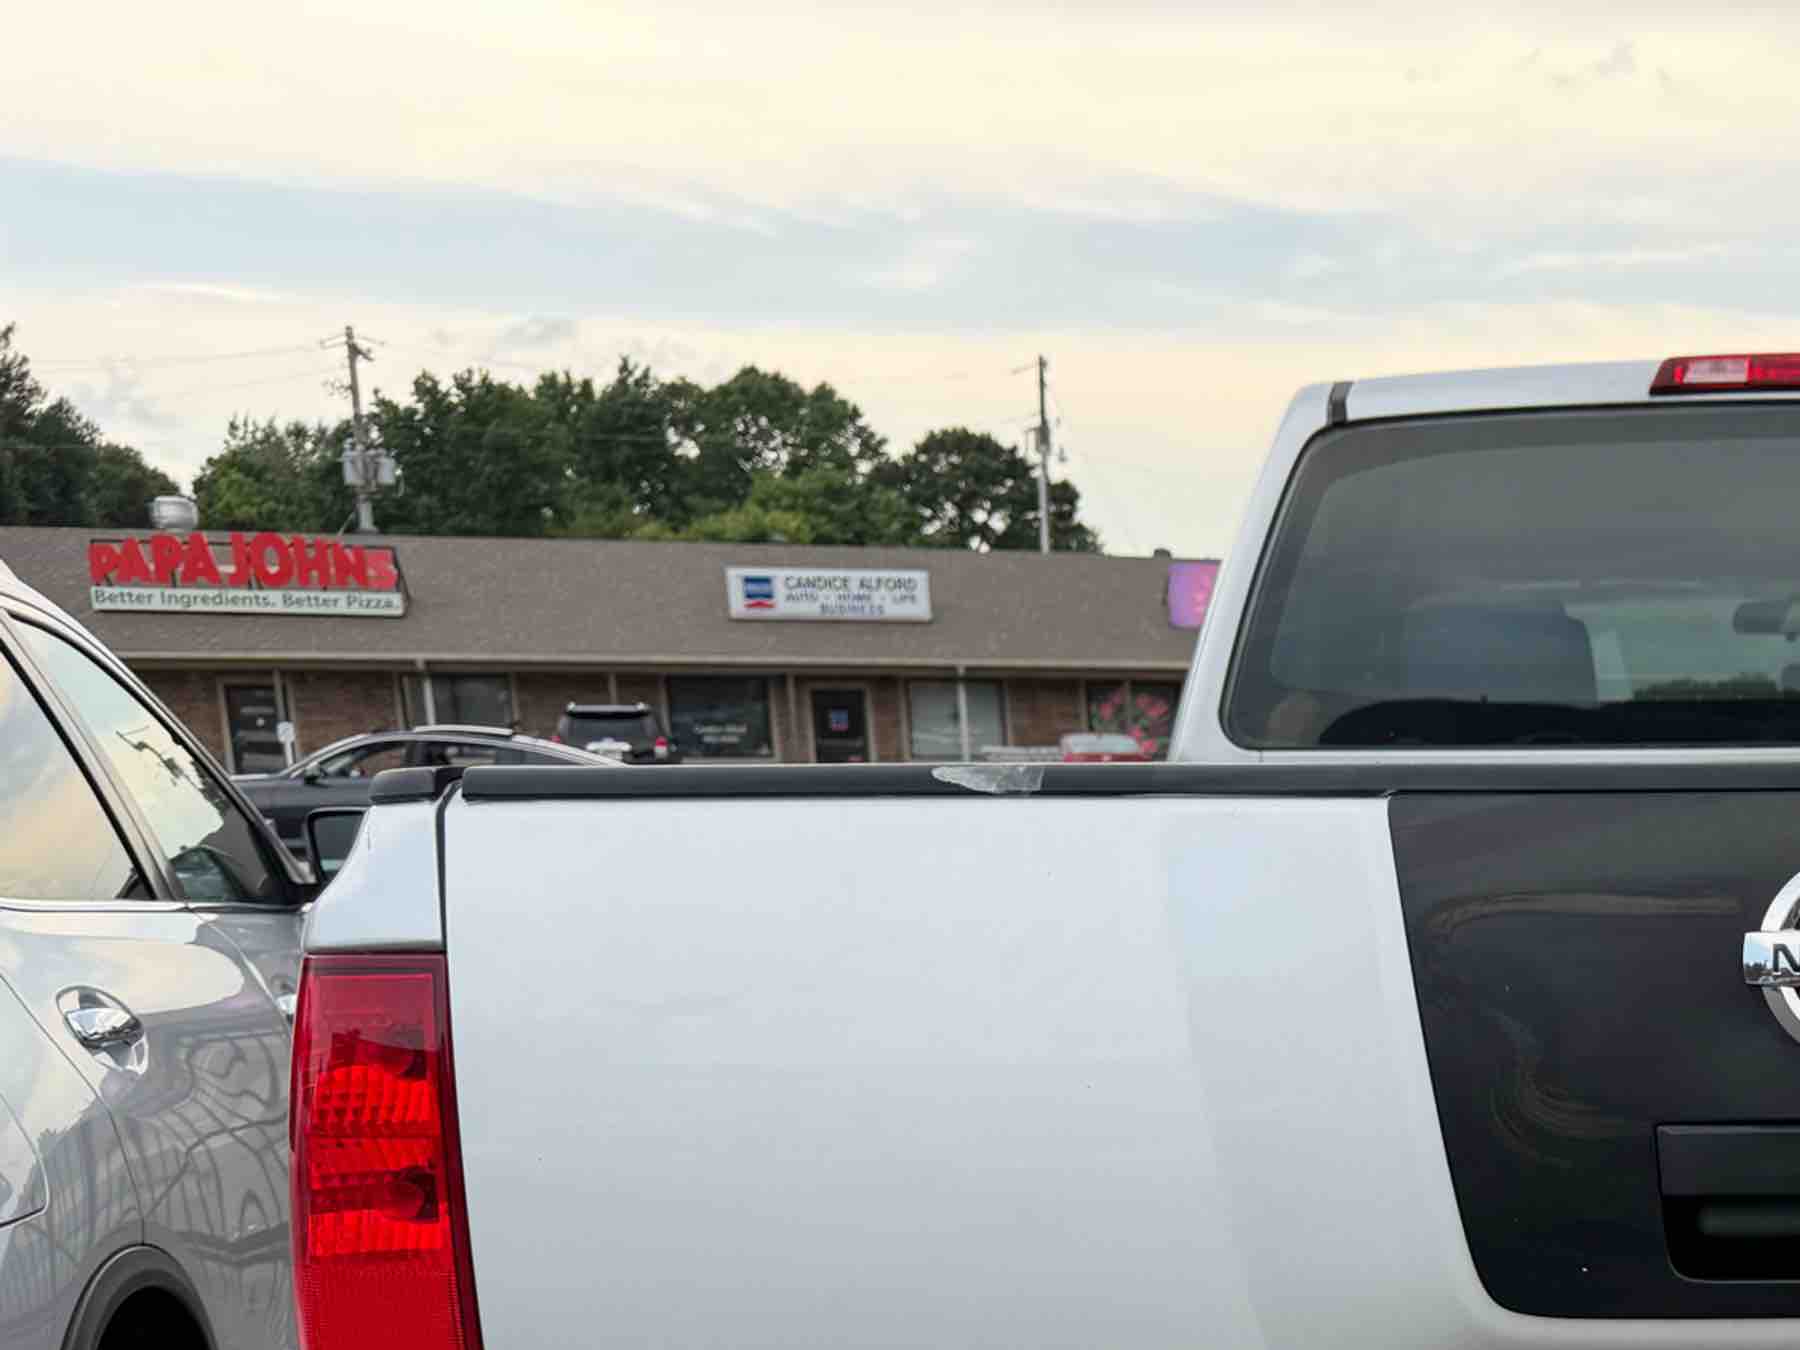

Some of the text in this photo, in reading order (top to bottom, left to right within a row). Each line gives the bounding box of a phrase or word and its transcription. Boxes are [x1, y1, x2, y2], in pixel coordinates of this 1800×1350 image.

[88, 532, 220, 584] PAPA
[785, 576, 848, 591] CANDICE
[859, 577, 918, 592] ALFORD
[95, 589, 153, 604] Better
[160, 591, 276, 607] Ingredients.
[283, 592, 338, 607] Better
